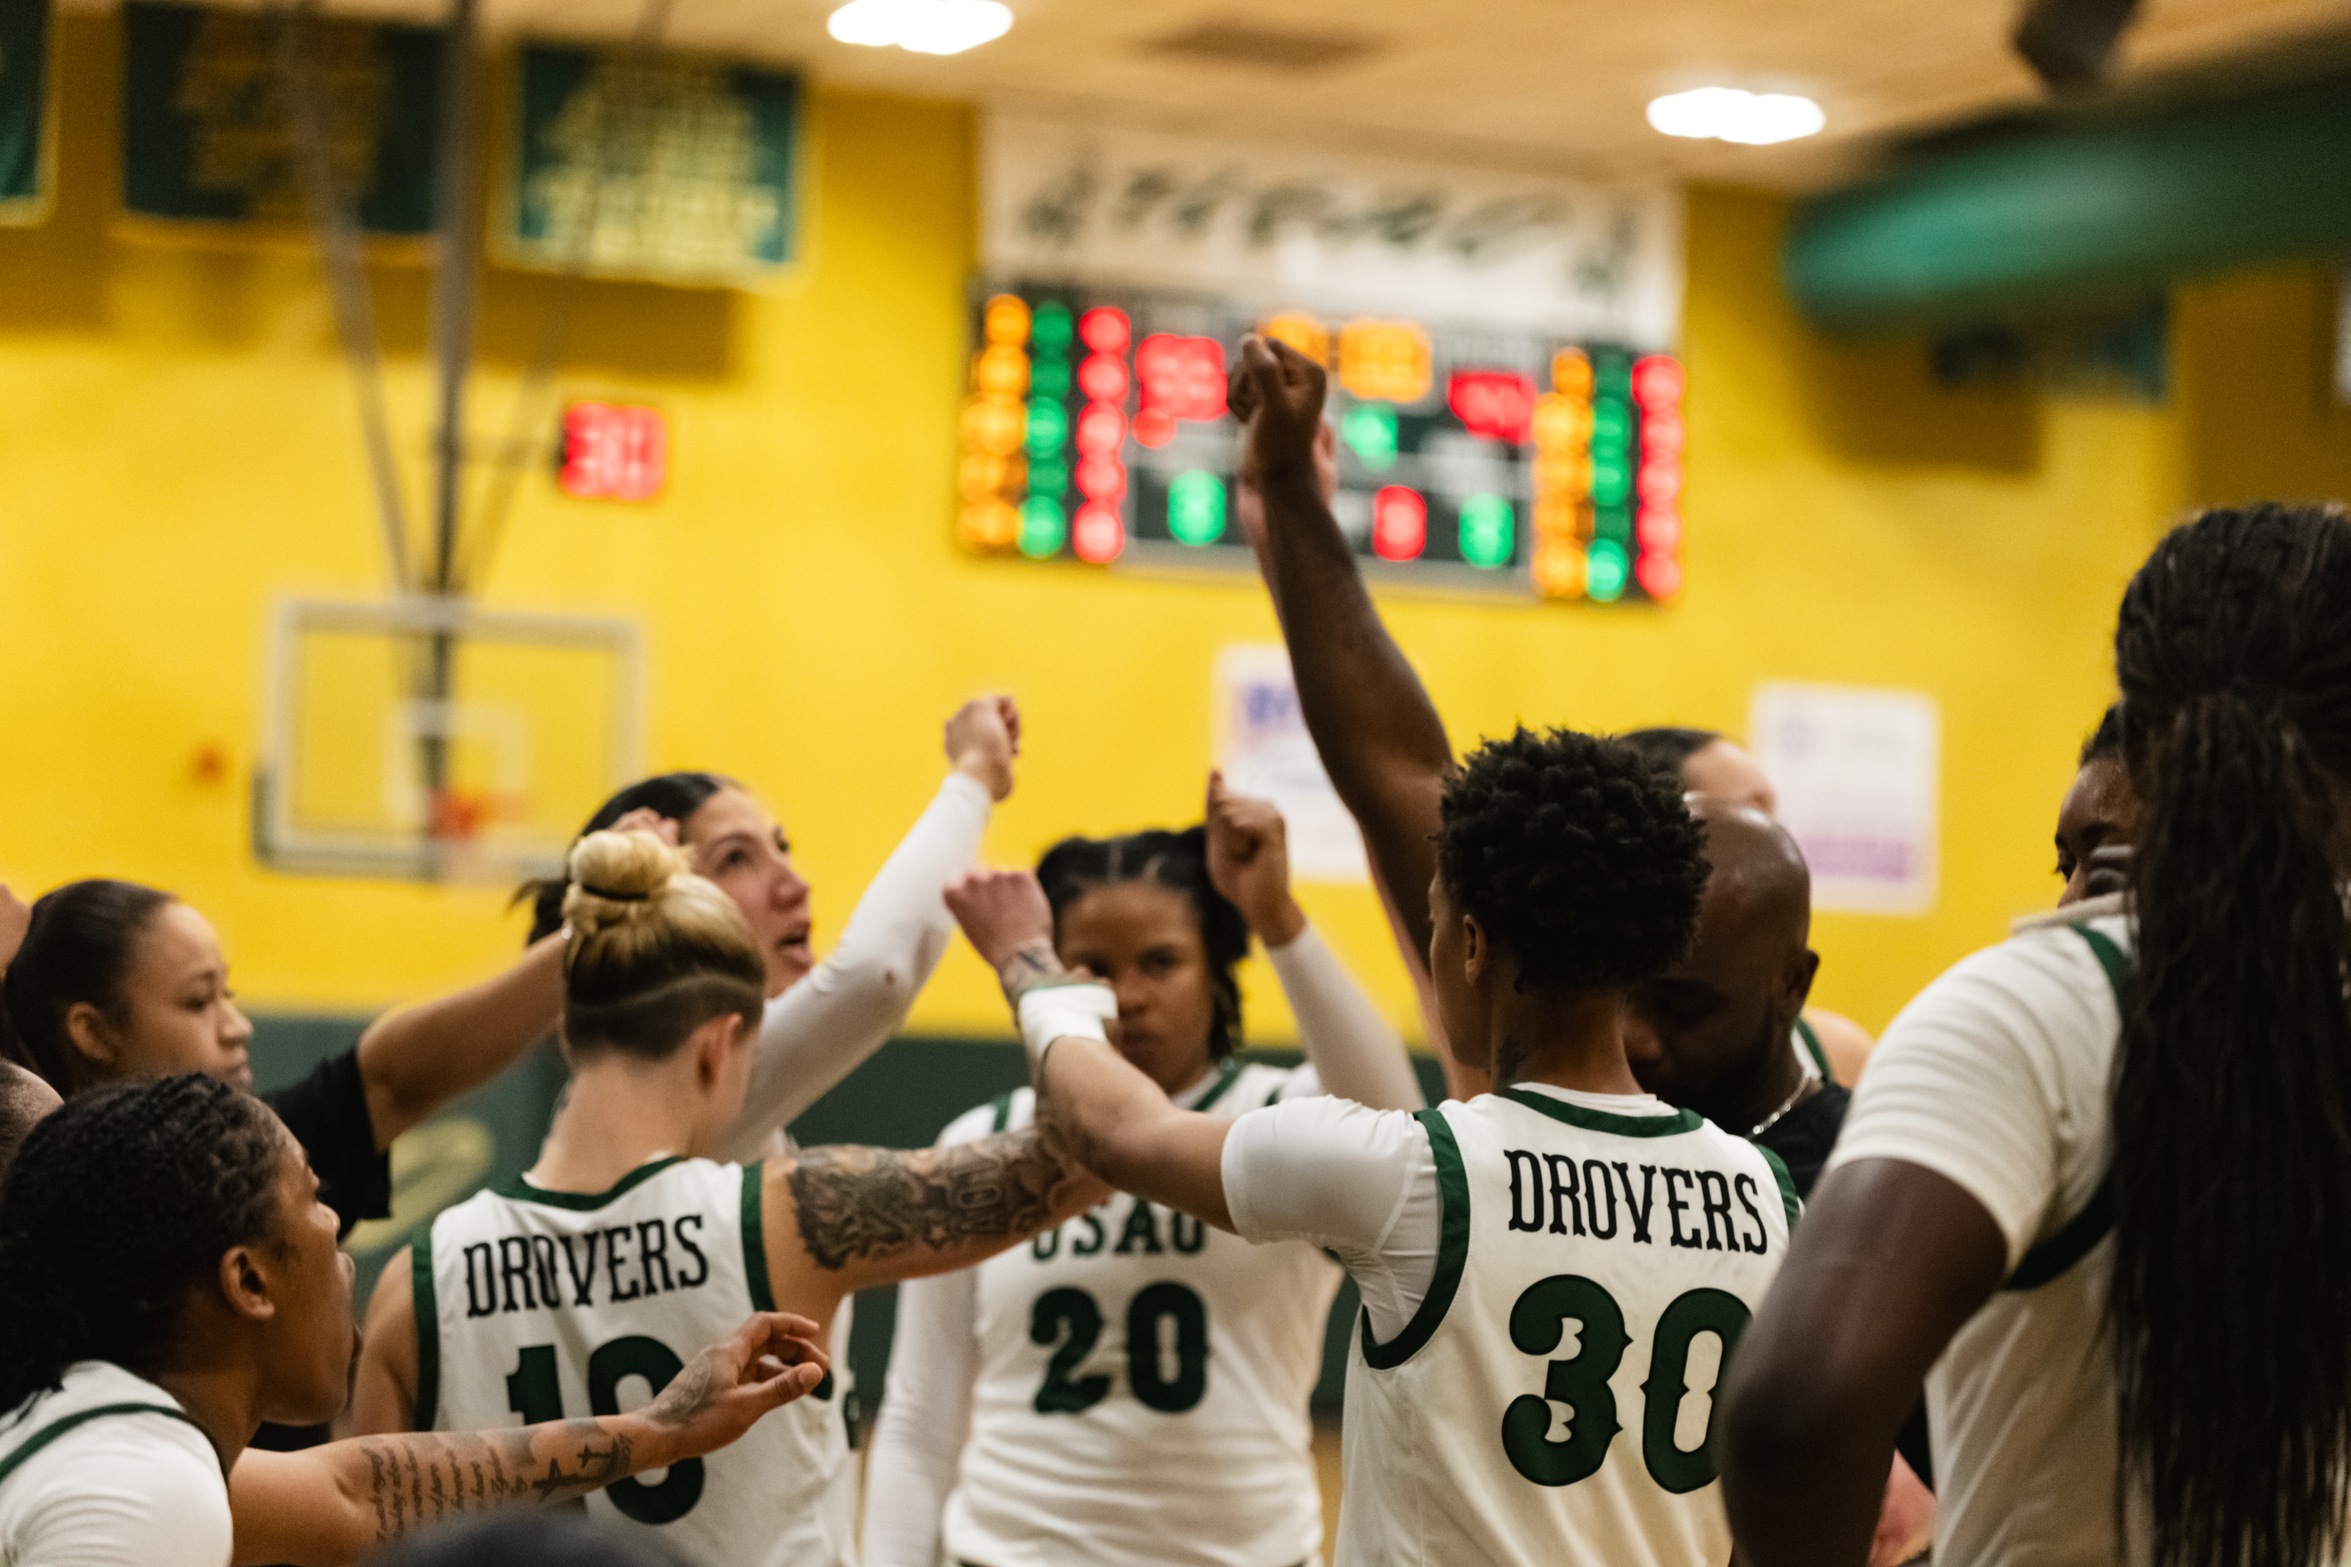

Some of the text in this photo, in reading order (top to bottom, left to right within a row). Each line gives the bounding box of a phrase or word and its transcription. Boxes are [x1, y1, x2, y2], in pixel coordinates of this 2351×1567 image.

[1503, 1149, 1768, 1255] DROVERS
[463, 1214, 709, 1318] DROVERS
[1029, 1280, 1208, 1414] 20
[1502, 1274, 1757, 1494] 30
